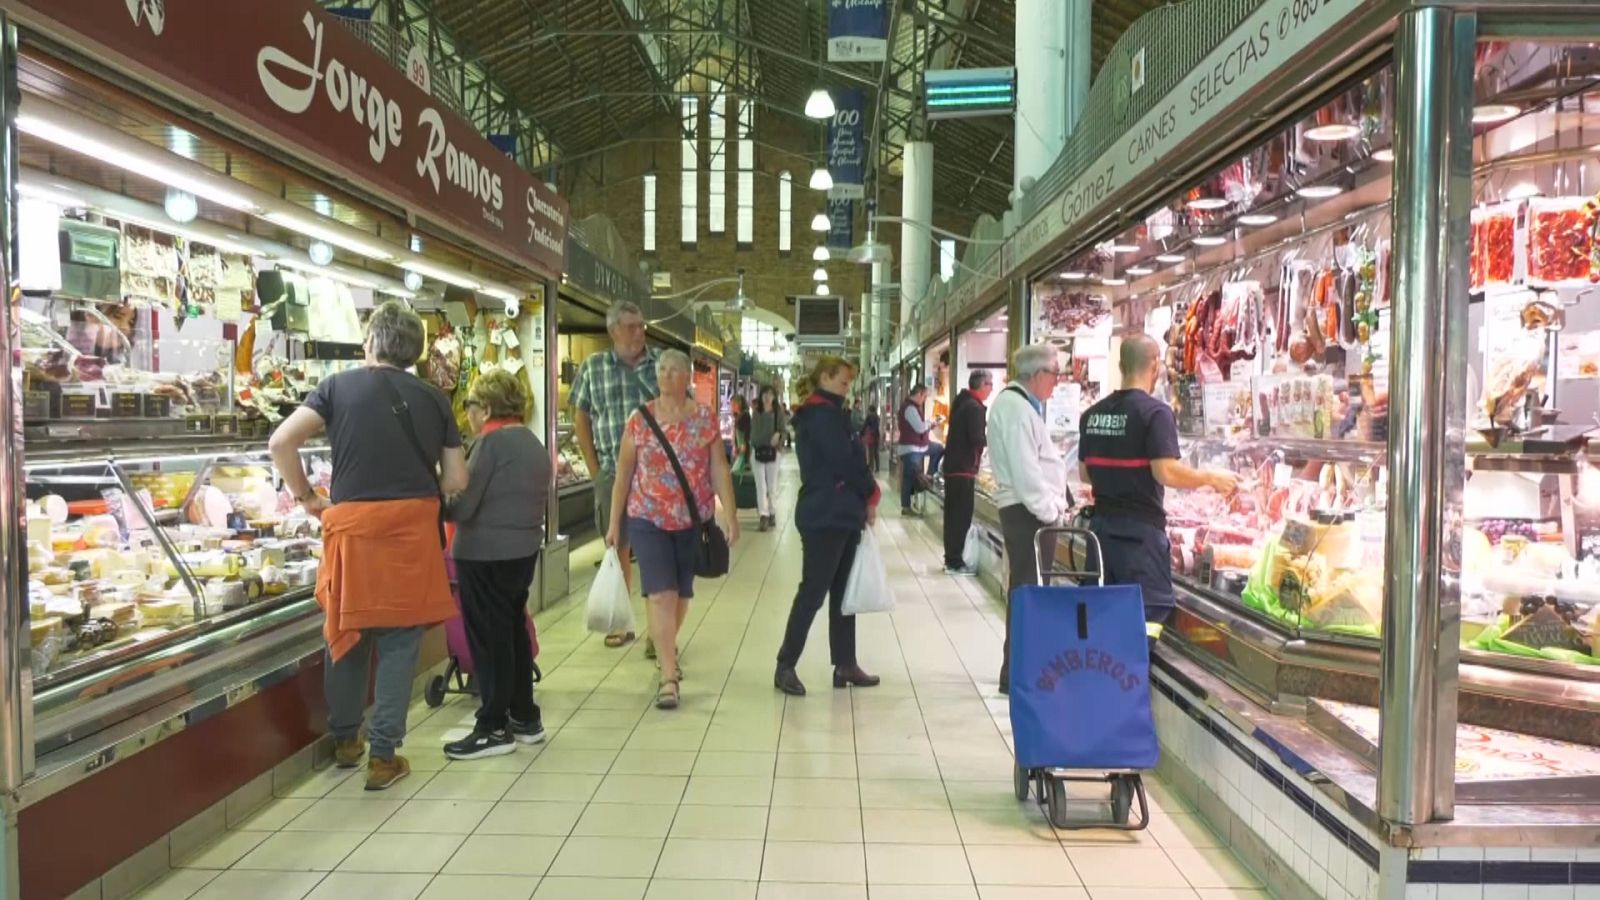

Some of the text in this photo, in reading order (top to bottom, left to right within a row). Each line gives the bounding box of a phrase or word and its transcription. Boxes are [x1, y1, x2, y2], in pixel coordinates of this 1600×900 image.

[257, 11, 503, 210] Jorge Ramos
[412, 61, 425, 86] 99
[832, 109, 860, 127] 100
[1061, 166, 1115, 226] Gómez
[1128, 105, 1176, 165] CARNES
[1190, 22, 1269, 116] SELECTAS
